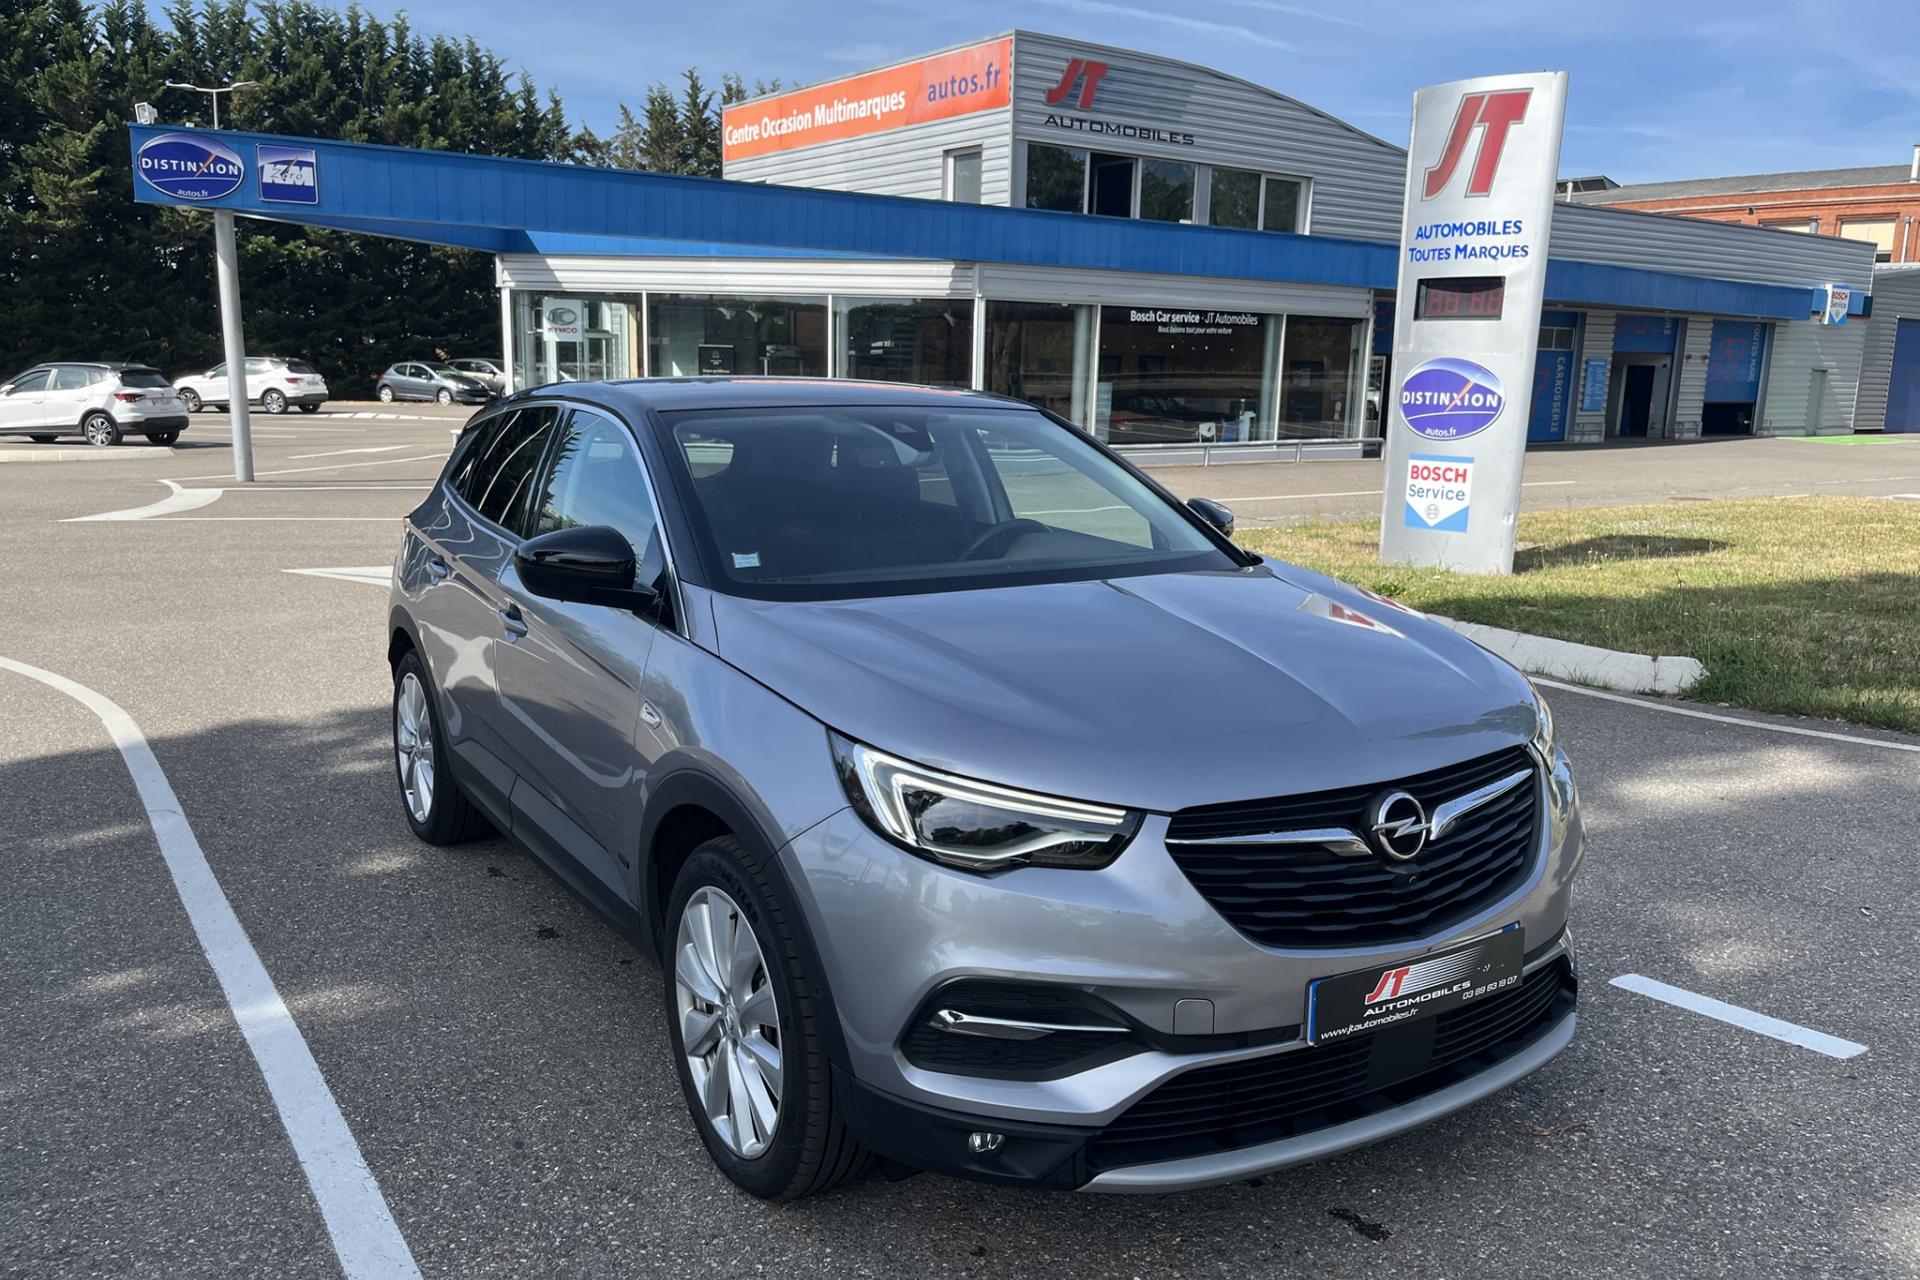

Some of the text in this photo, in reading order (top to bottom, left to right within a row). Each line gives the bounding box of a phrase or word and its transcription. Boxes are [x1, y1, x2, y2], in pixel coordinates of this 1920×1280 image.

[1044, 57, 1110, 111] JT
[725, 62, 1001, 146] Centre Occasion Multimarques autos.fr
[1044, 115, 1195, 146] AUTOMOBILES
[1421, 87, 1534, 201] JT
[141, 158, 239, 175] DISTINXION
[177, 188, 208, 198] autos.fr
[1415, 220, 1523, 241] AUTOMOBILES
[1409, 244, 1529, 262] TOUTES MARQUES
[1130, 310, 1155, 322] Bosch
[1156, 311, 1170, 322] Car
[1171, 312, 1200, 323] service
[1205, 312, 1214, 324] JT
[1215, 314, 1258, 325] Automobiles
[1402, 391, 1498, 408] DISTINXION
[1550, 356, 1567, 433] CARROSSERIE
[1425, 426, 1457, 437] autos.fr
[1410, 465, 1467, 483] BOSCH
[1408, 484, 1466, 501] Service
[1364, 965, 1412, 1005] JT
[1462, 990, 1474, 1000] 03
[1507, 975, 1518, 985] 07
[1363, 980, 1471, 1017] AUTOMOBILES
[1321, 1007, 1419, 1040] www.jtautomobiles.fr
